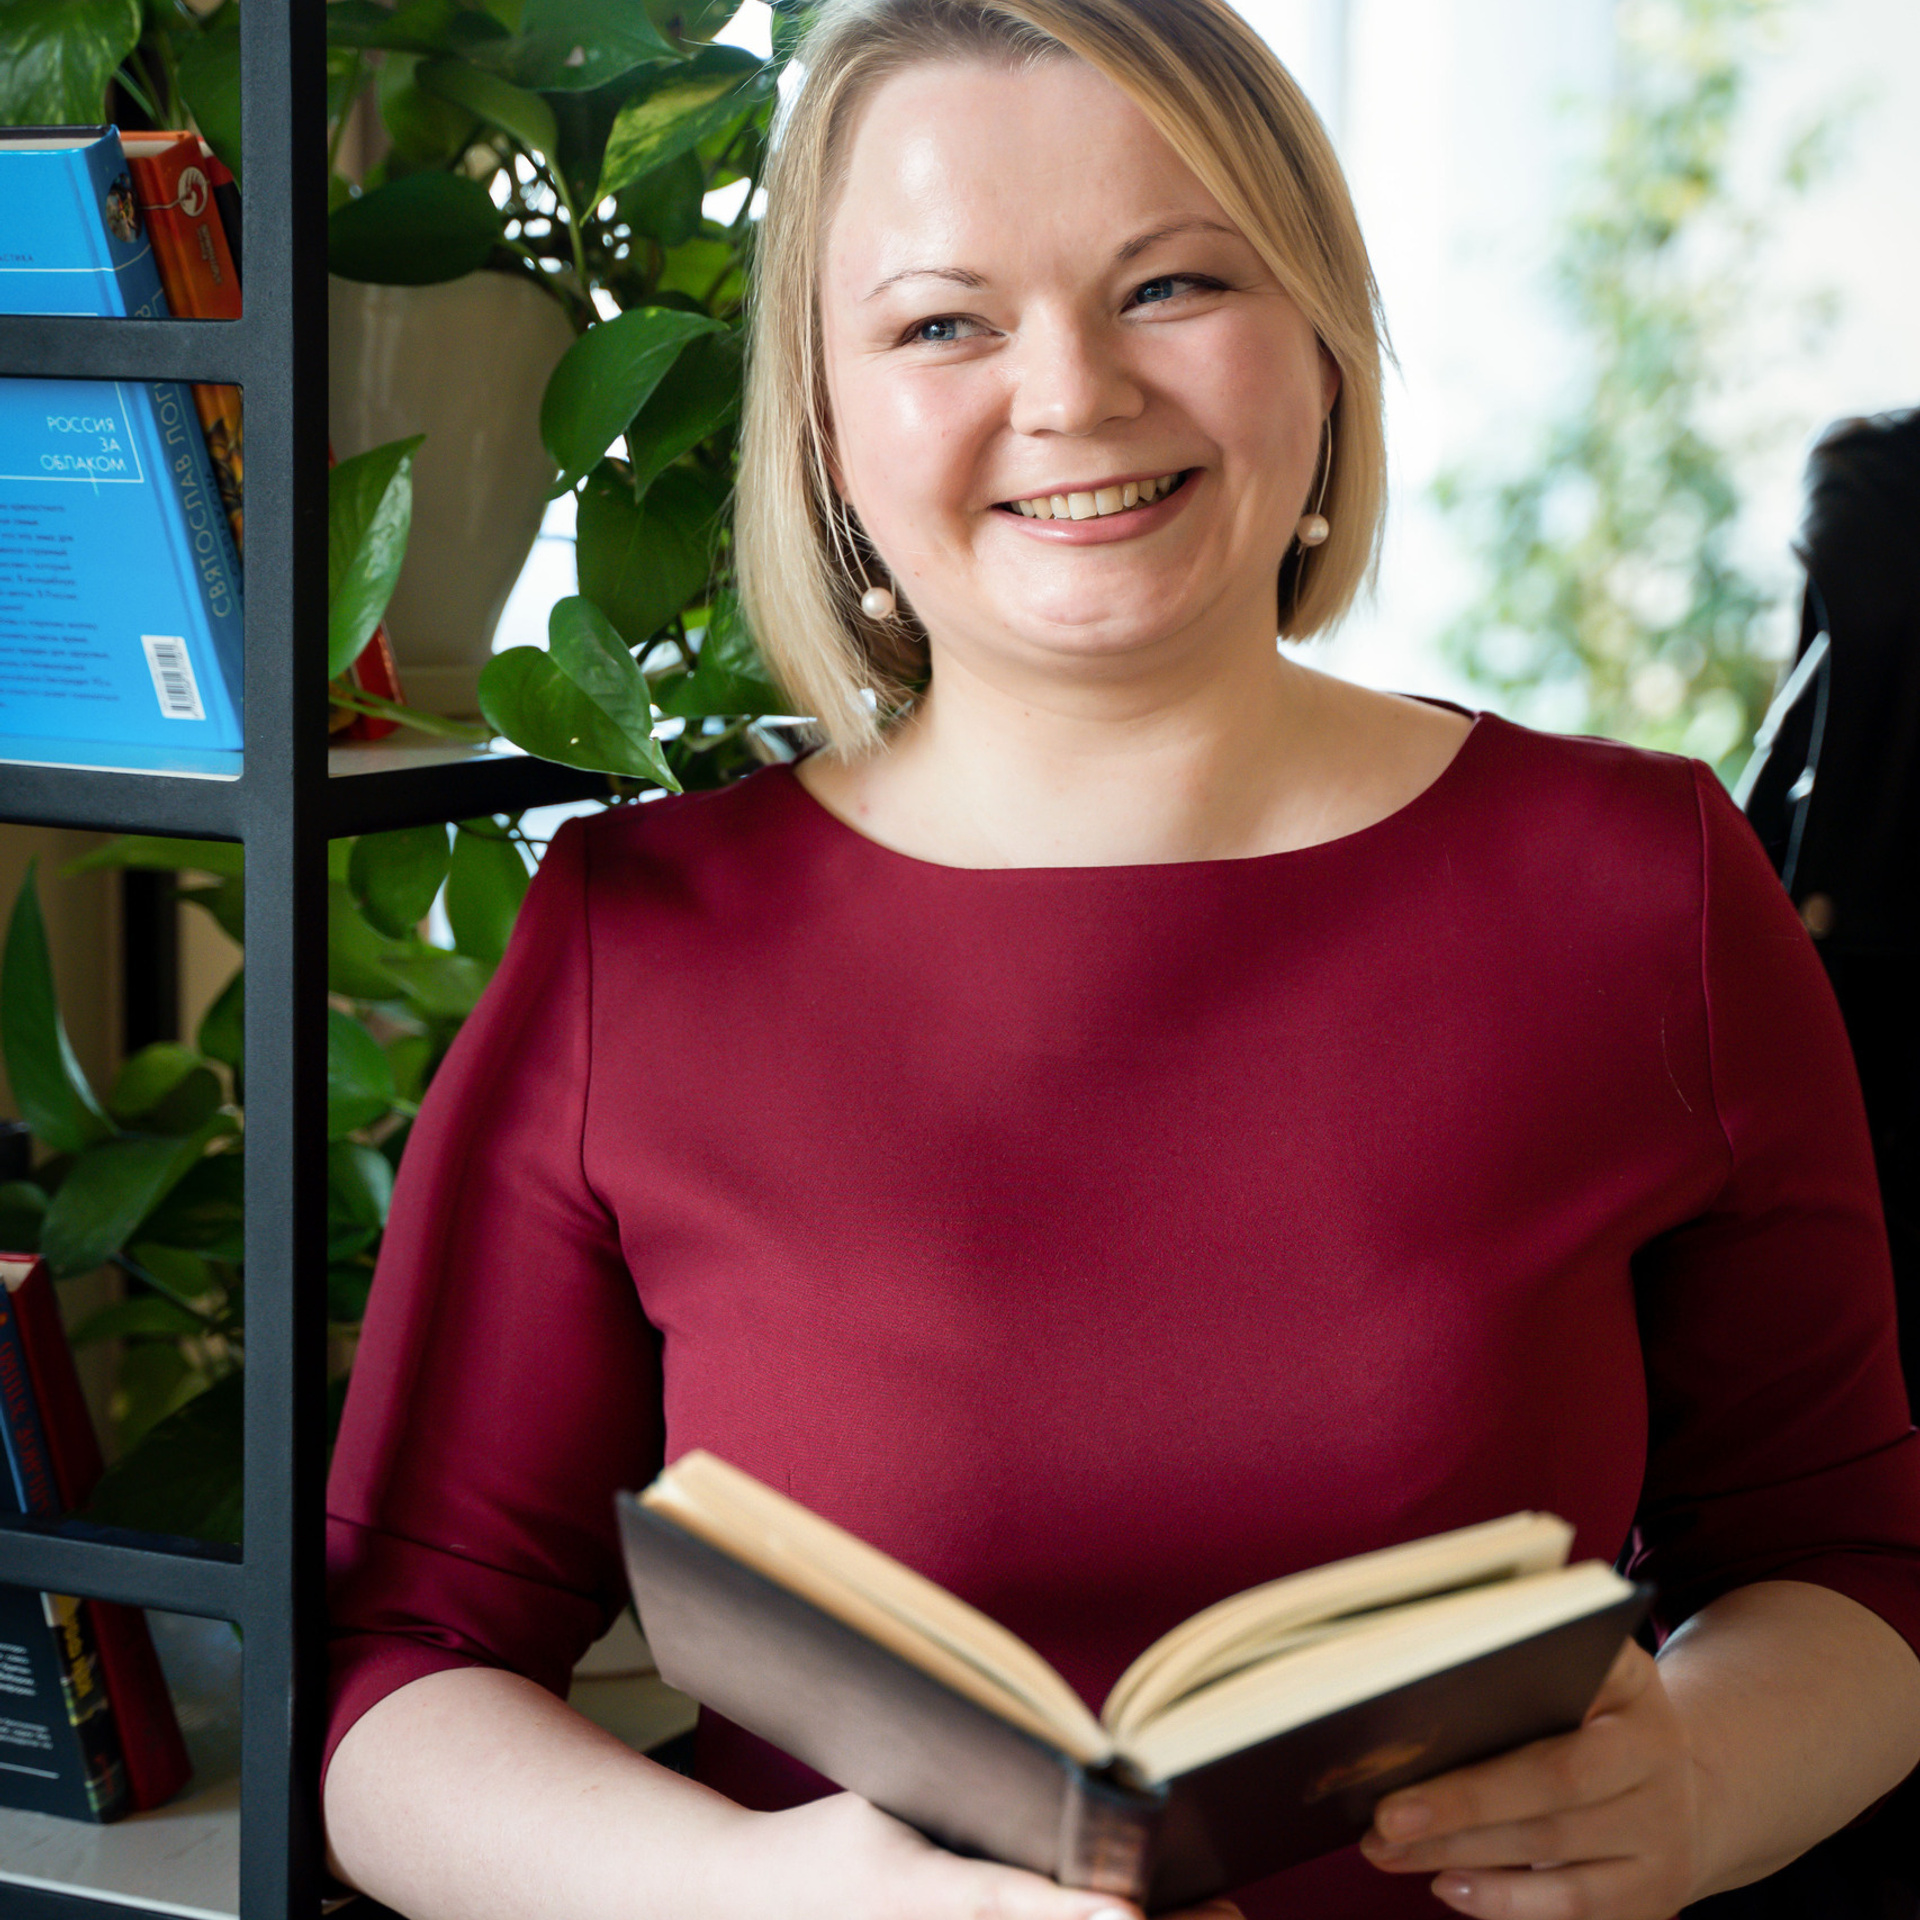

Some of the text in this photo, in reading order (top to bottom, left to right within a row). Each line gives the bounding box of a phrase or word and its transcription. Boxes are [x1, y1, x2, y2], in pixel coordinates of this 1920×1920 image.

[153, 382, 185, 446] ЛОГ
[46, 417, 116, 433] РОССИЯ
[99, 437, 122, 453] ЗА
[40, 455, 128, 472] ОБЛАКОМ
[174, 454, 232, 618] СВЯТОСЛАВ
